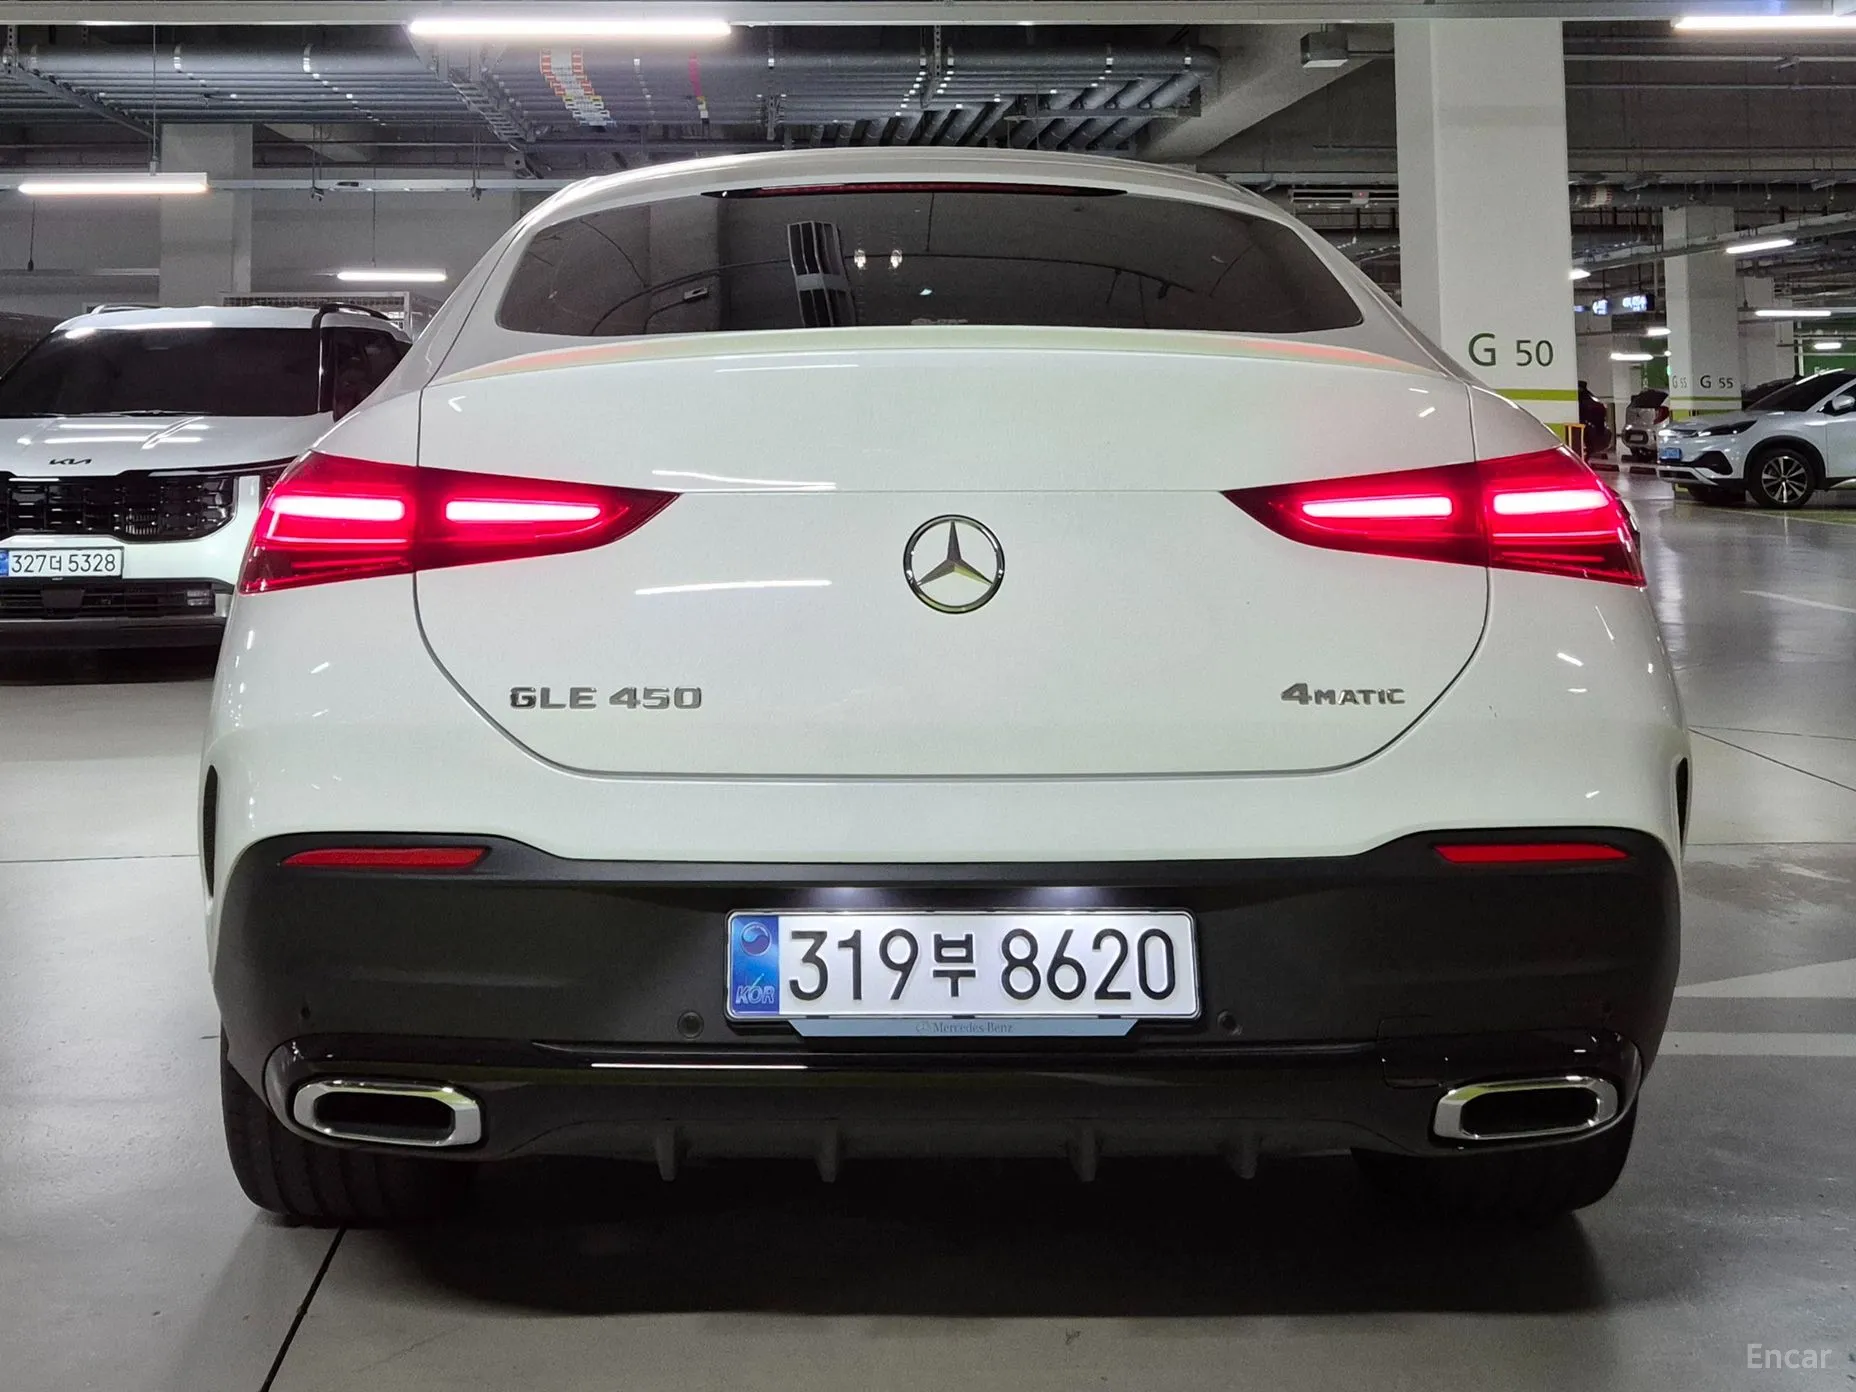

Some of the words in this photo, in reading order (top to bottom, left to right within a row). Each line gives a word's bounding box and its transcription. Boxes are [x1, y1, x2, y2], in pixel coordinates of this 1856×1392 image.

[1468, 332, 1497, 367] G
[1515, 339, 1554, 367] 50
[1700, 374, 1712, 389] G
[1718, 377, 1734, 389] 55
[68, 553, 116, 573] 5328
[510, 686, 598, 710] GLE
[608, 686, 702, 710] 450
[1280, 682, 1406, 706] 4MATIC
[788, 927, 977, 1001] 319부
[1000, 927, 1176, 1001] 8620
[735, 984, 776, 1005] KOR
